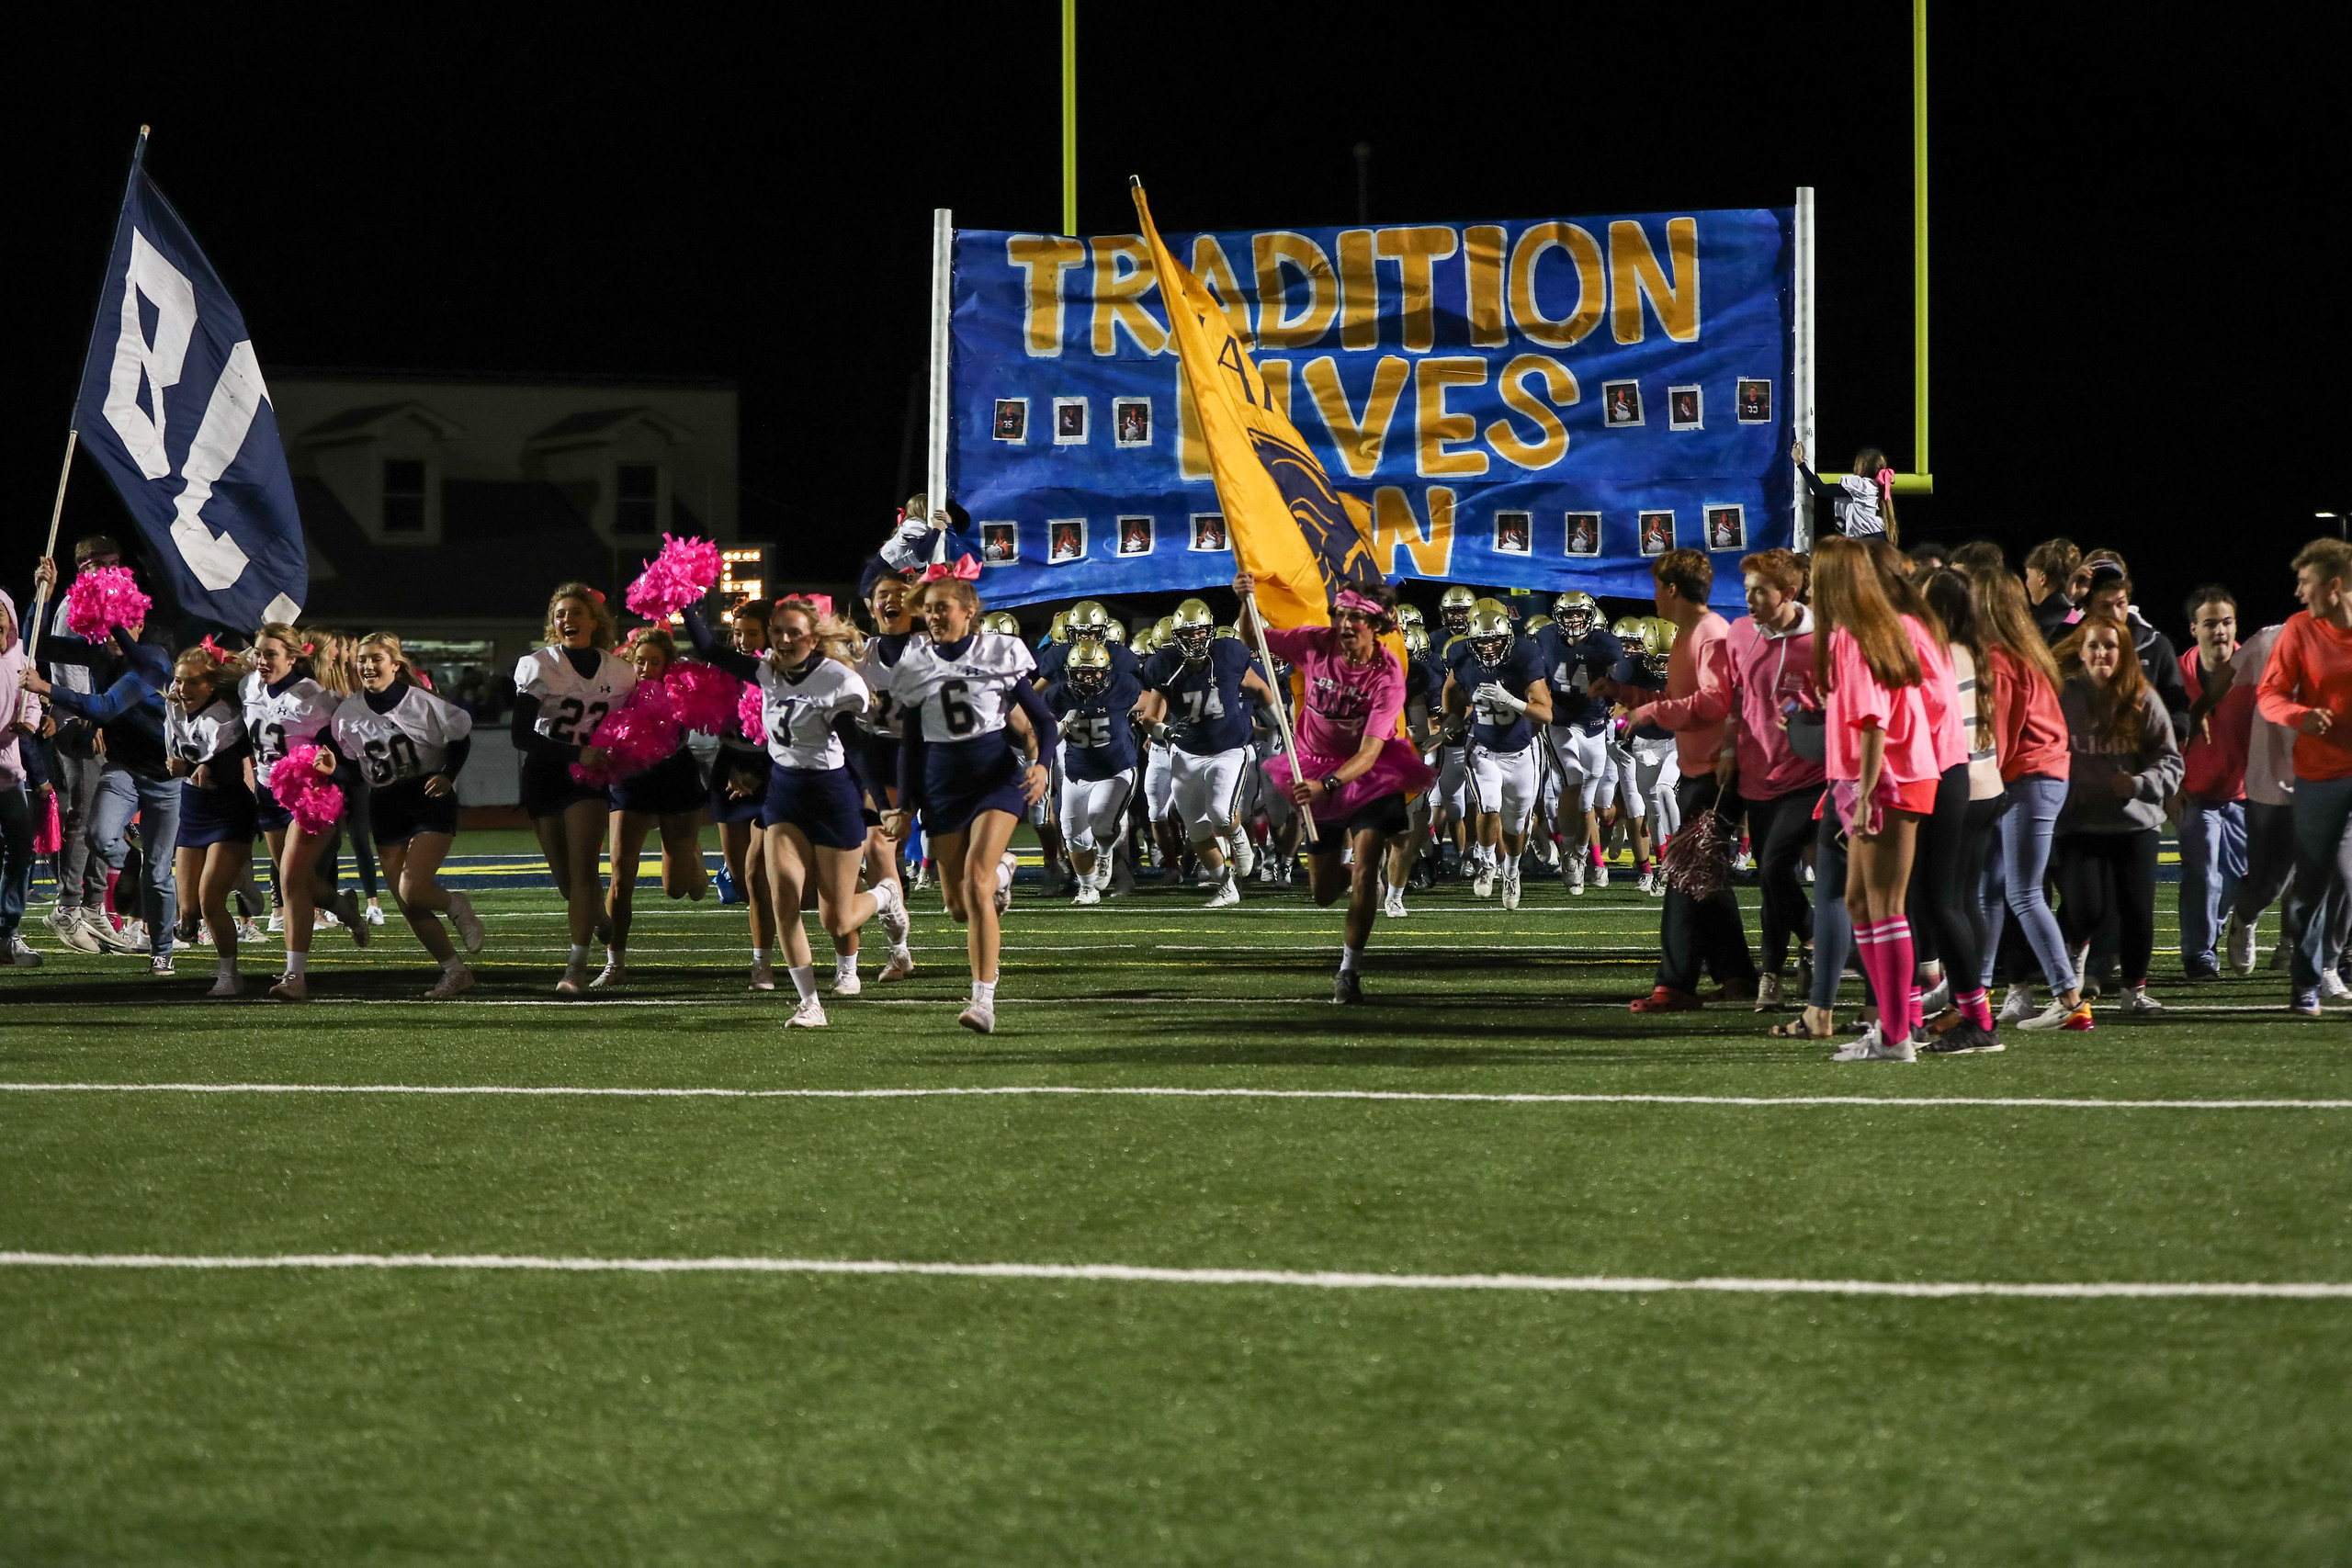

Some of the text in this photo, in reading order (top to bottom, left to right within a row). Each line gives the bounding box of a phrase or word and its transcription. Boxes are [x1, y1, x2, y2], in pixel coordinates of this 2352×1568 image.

[1006, 217, 1700, 357] TRADITION
[1554, 661, 1589, 694] 44
[940, 680, 976, 735] 6
[1182, 687, 1225, 724] 74
[1069, 716, 1111, 749] 55
[364, 734, 422, 782] 60
